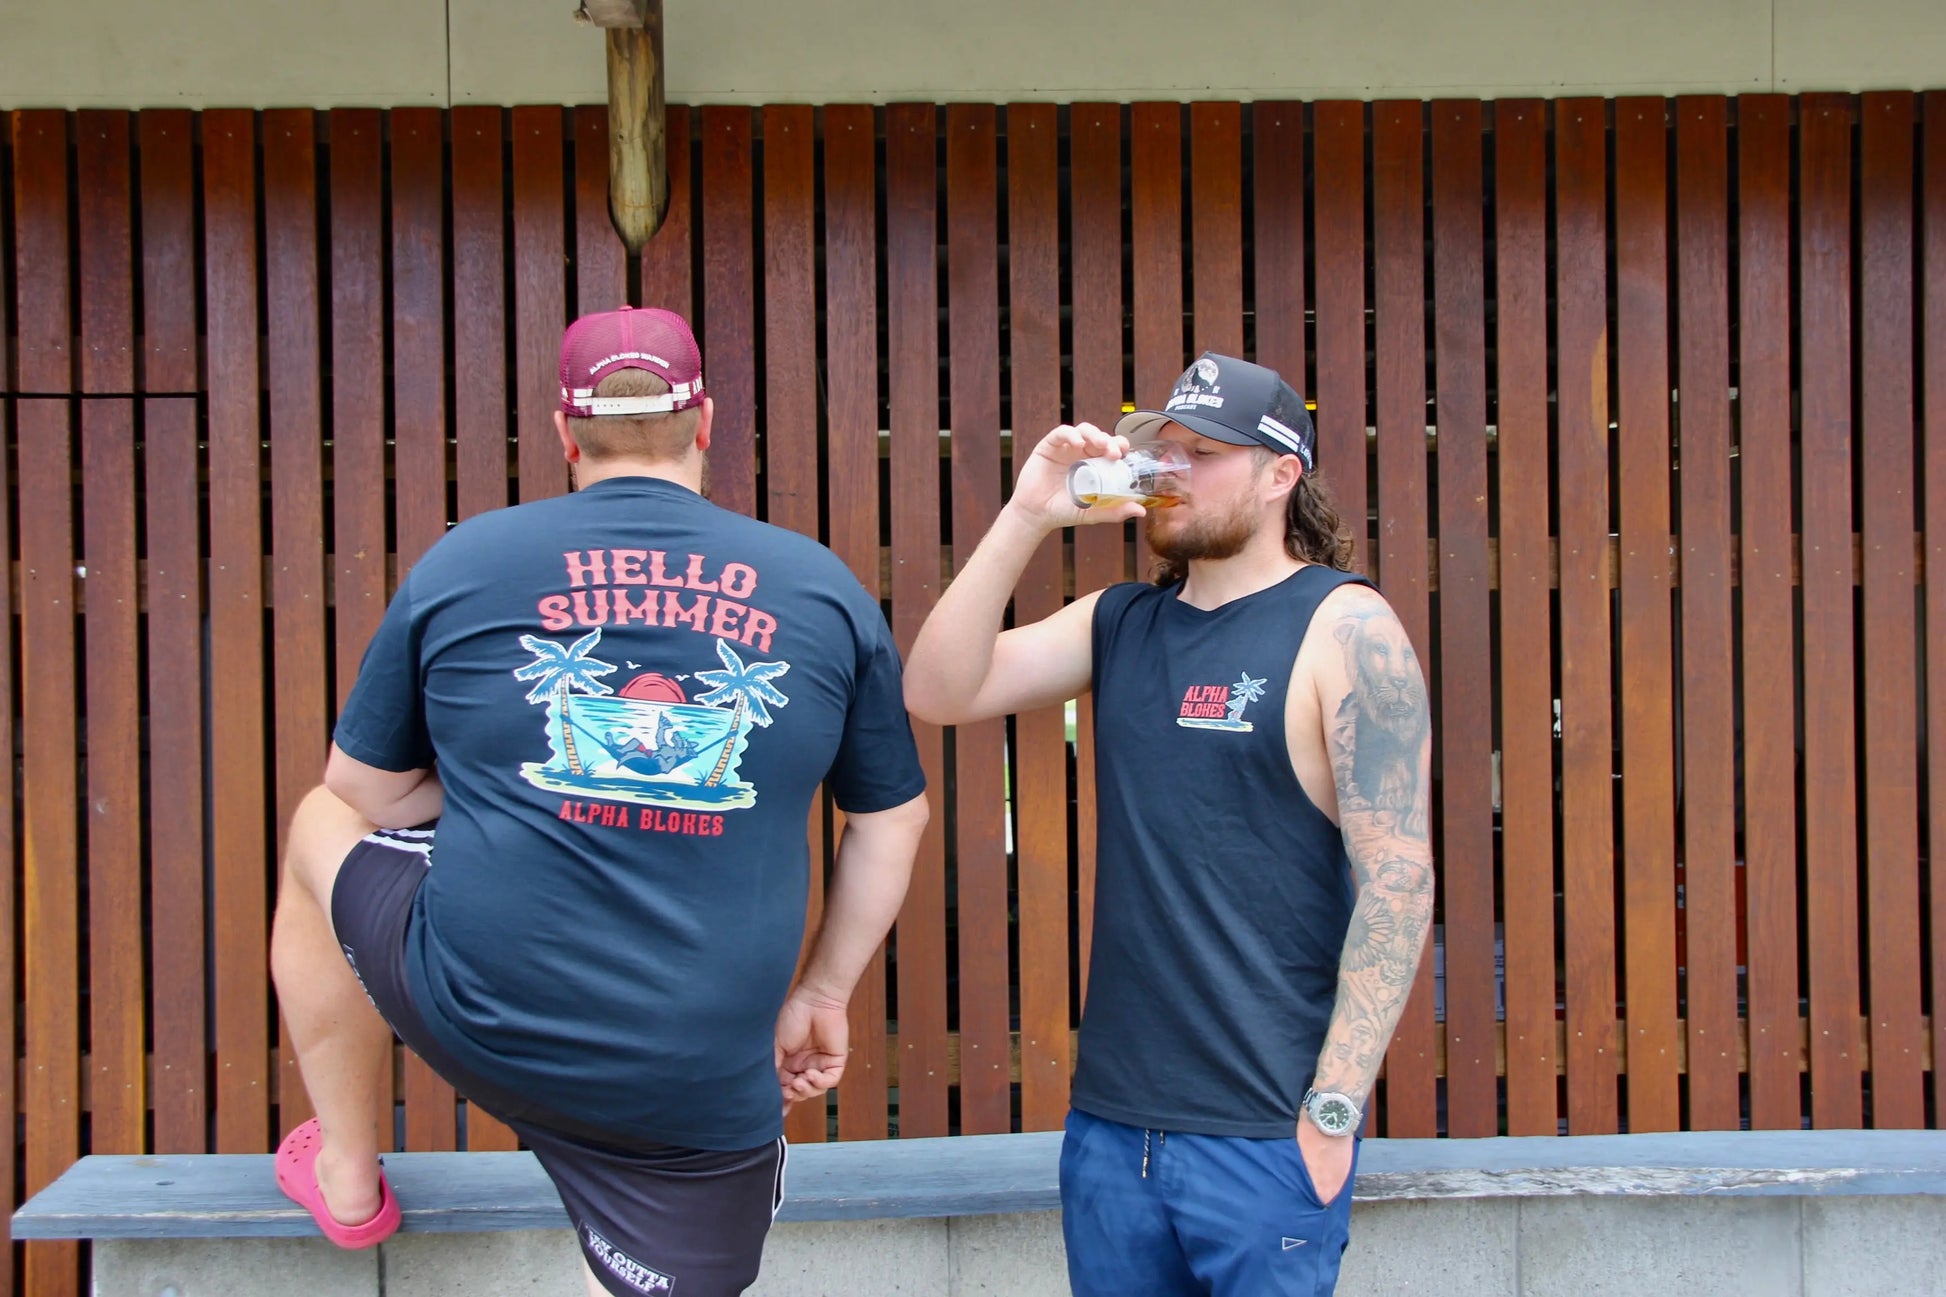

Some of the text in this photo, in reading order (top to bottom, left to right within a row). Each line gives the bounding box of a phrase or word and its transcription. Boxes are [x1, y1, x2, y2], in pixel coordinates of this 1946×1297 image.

[563, 549, 758, 599] HELLO
[537, 588, 778, 653] SUMMER
[1180, 702, 1227, 718] BLOKES
[1183, 684, 1229, 702] ALPHA
[558, 800, 725, 837] ALPHA BLOKES
[613, 1251, 669, 1289] OUTTA
